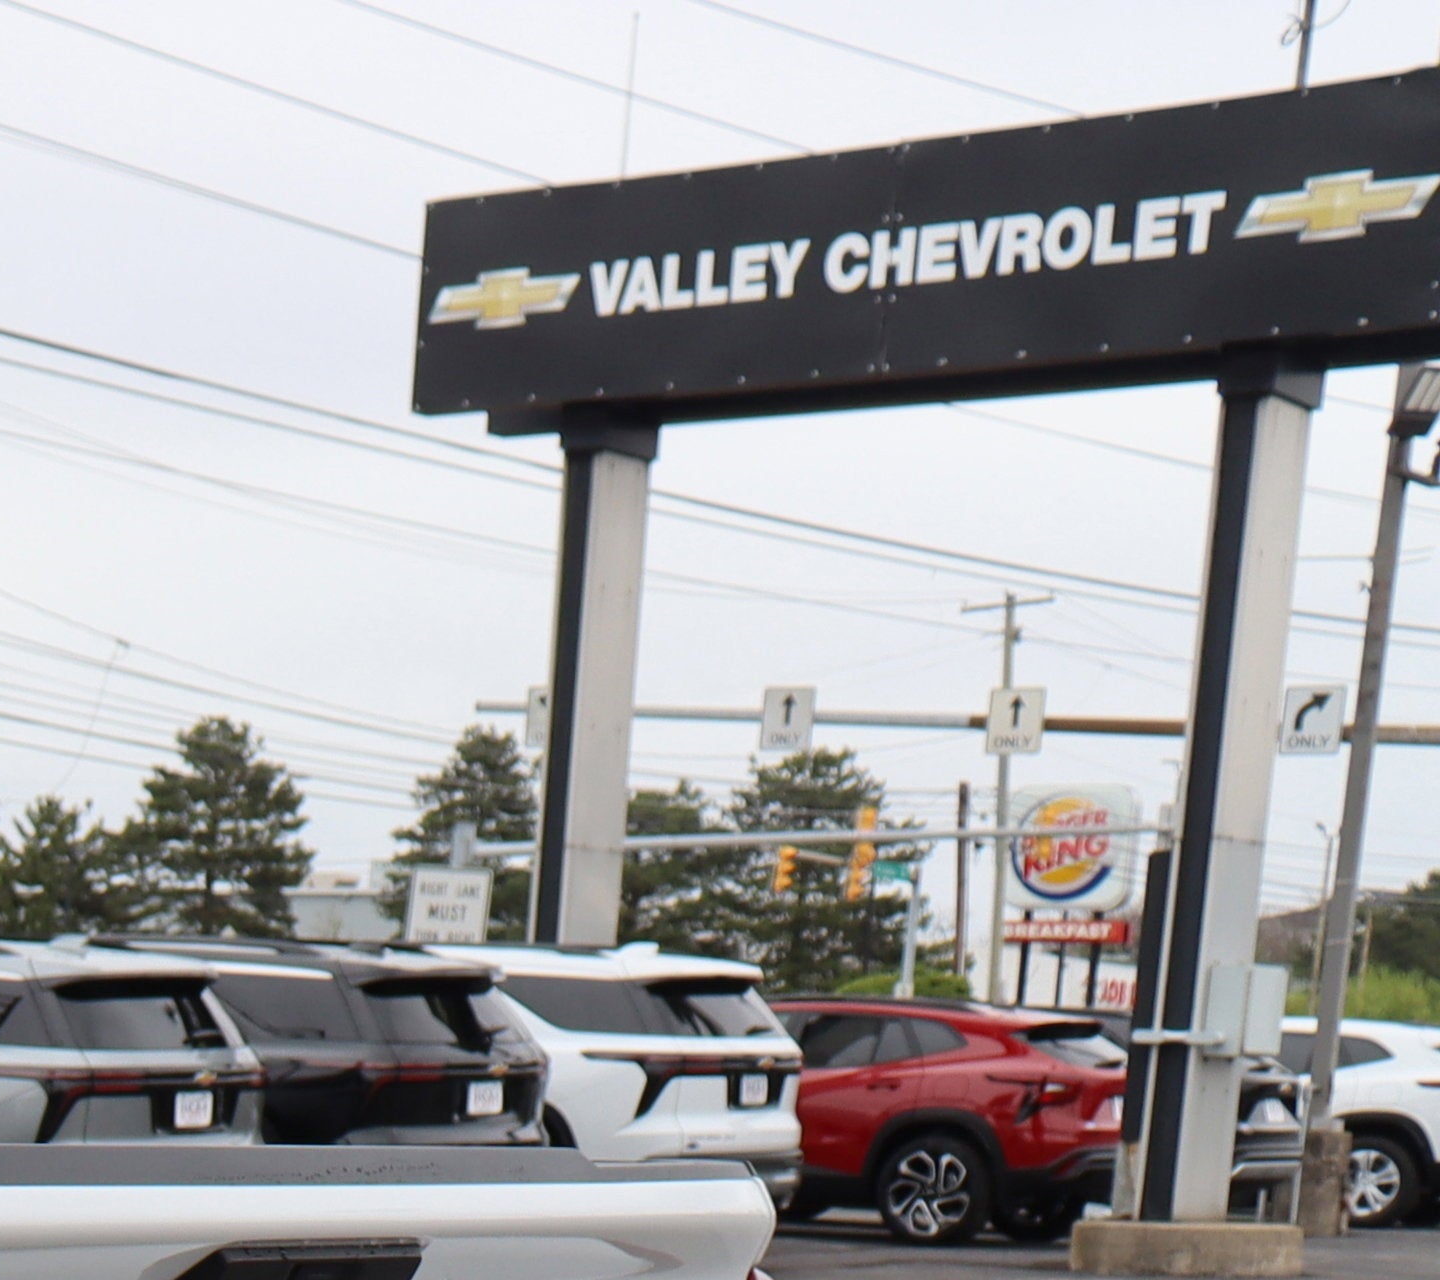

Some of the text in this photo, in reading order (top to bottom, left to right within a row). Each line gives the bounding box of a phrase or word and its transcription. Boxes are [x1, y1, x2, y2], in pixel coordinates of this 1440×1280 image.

[590, 190, 1227, 317] VALLEY CHEVROLET
[770, 732, 802, 745] ONLY
[993, 737, 1035, 749] ONLY
[1287, 733, 1331, 750] ONLY
[427, 902, 467, 922] MUST
